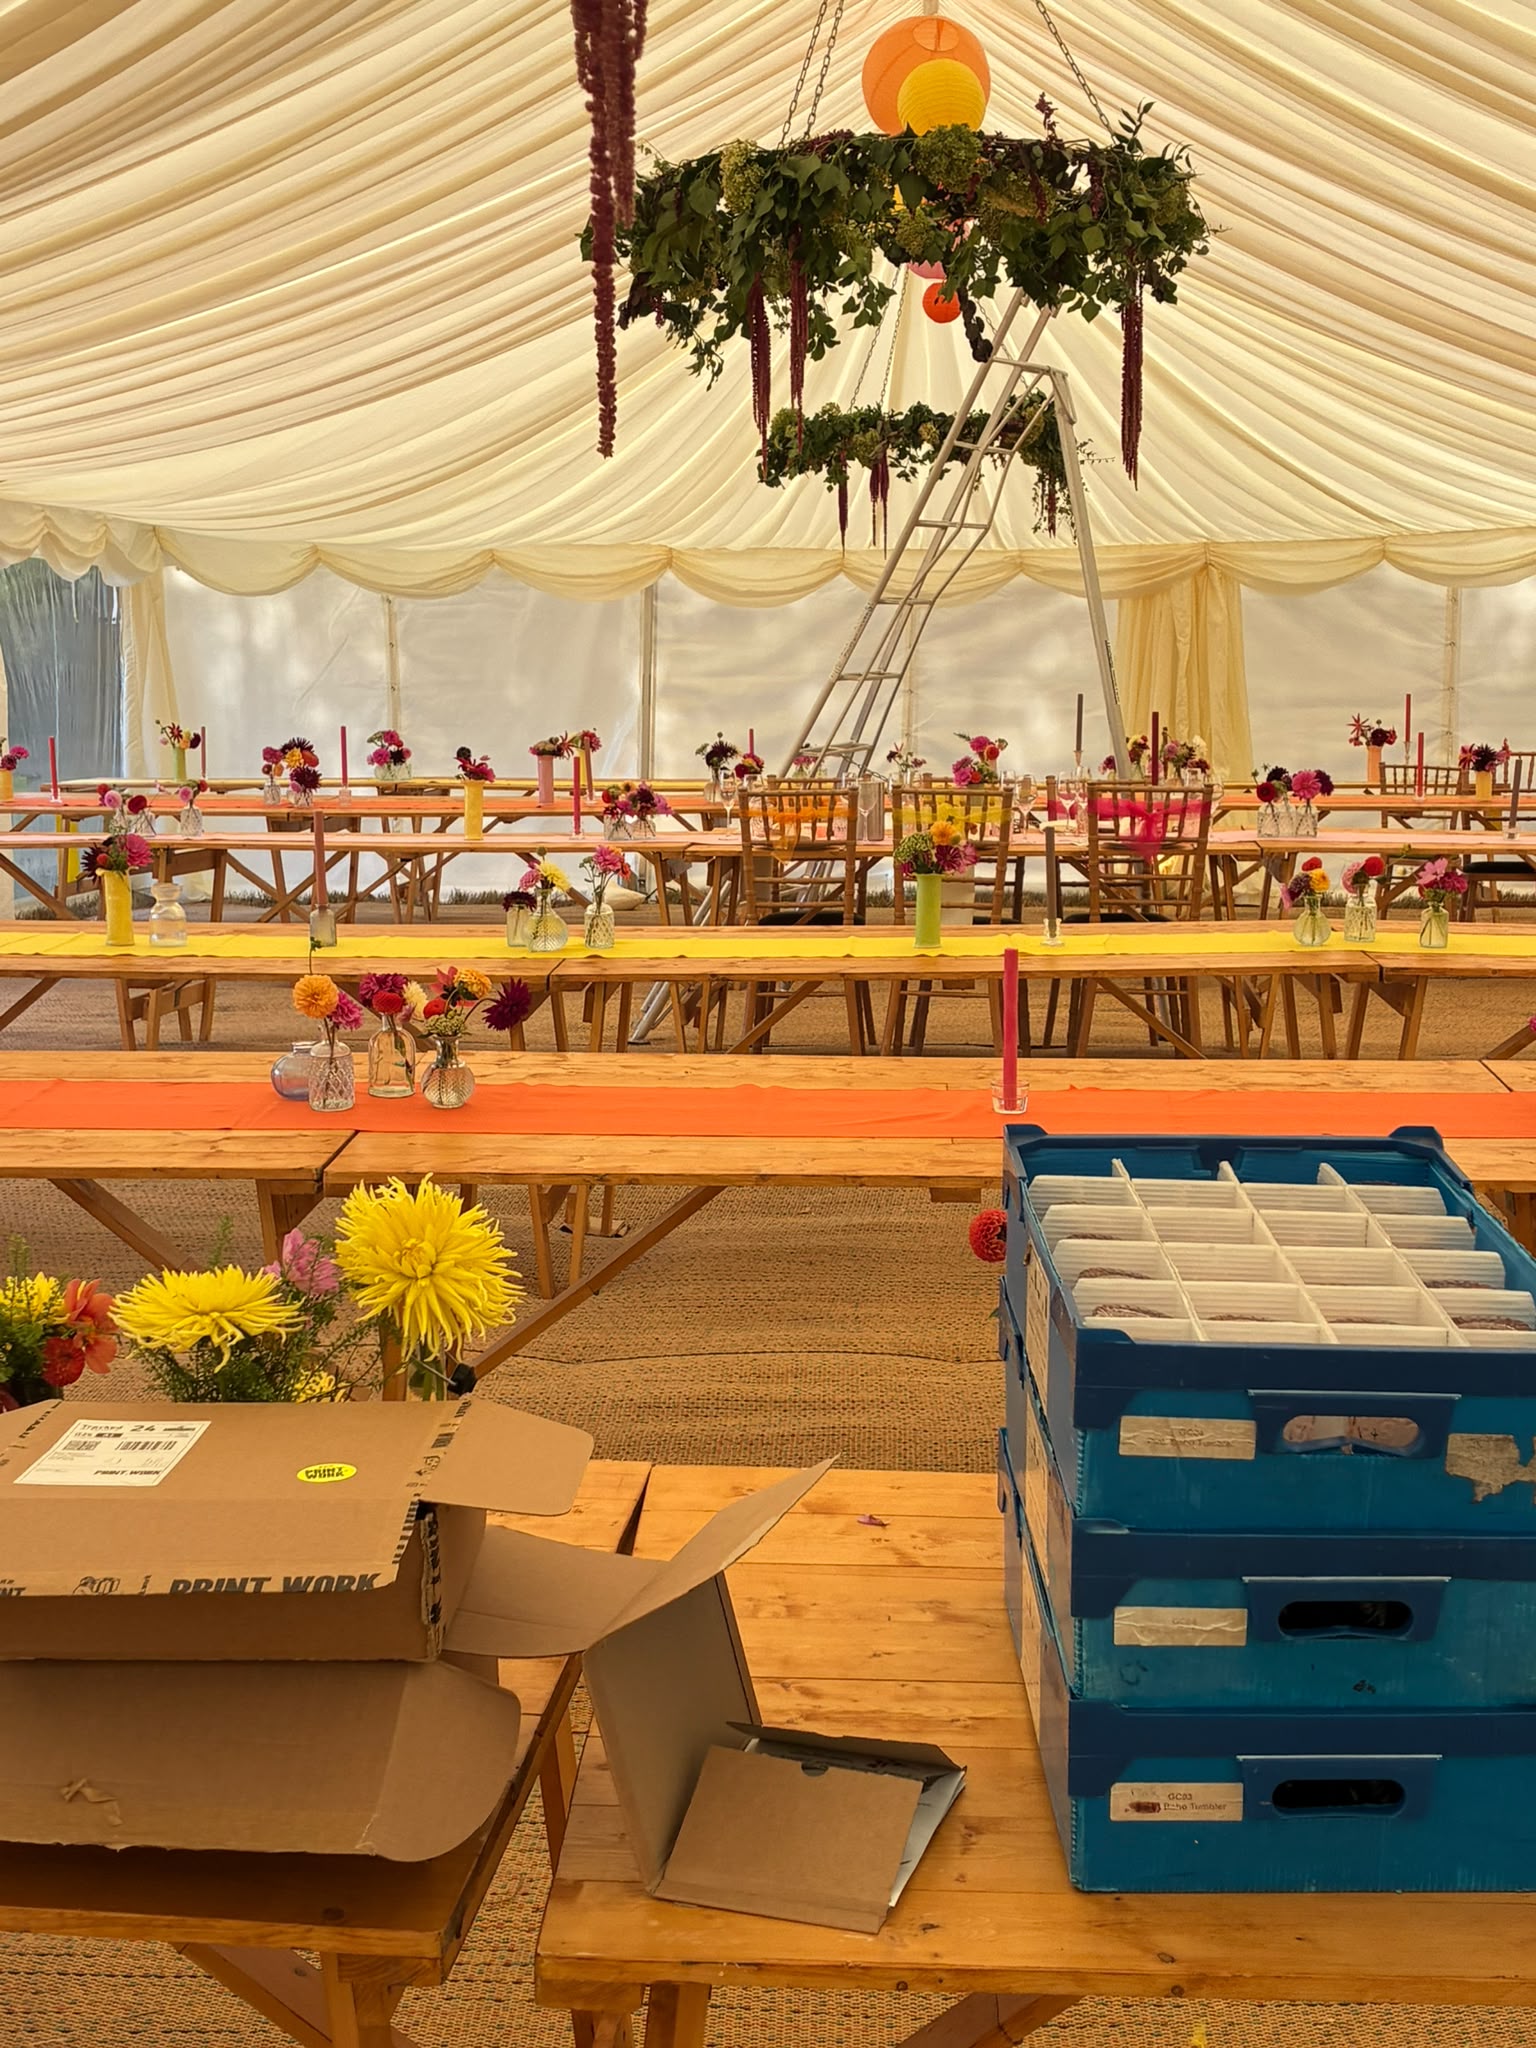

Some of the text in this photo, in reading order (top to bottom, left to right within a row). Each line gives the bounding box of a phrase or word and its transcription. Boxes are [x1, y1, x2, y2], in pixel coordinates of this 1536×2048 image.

[130, 1424, 156, 1432] 24
[170, 1572, 381, 1595] PRINT WORK
[1190, 1802, 1227, 1811] Tumbler
